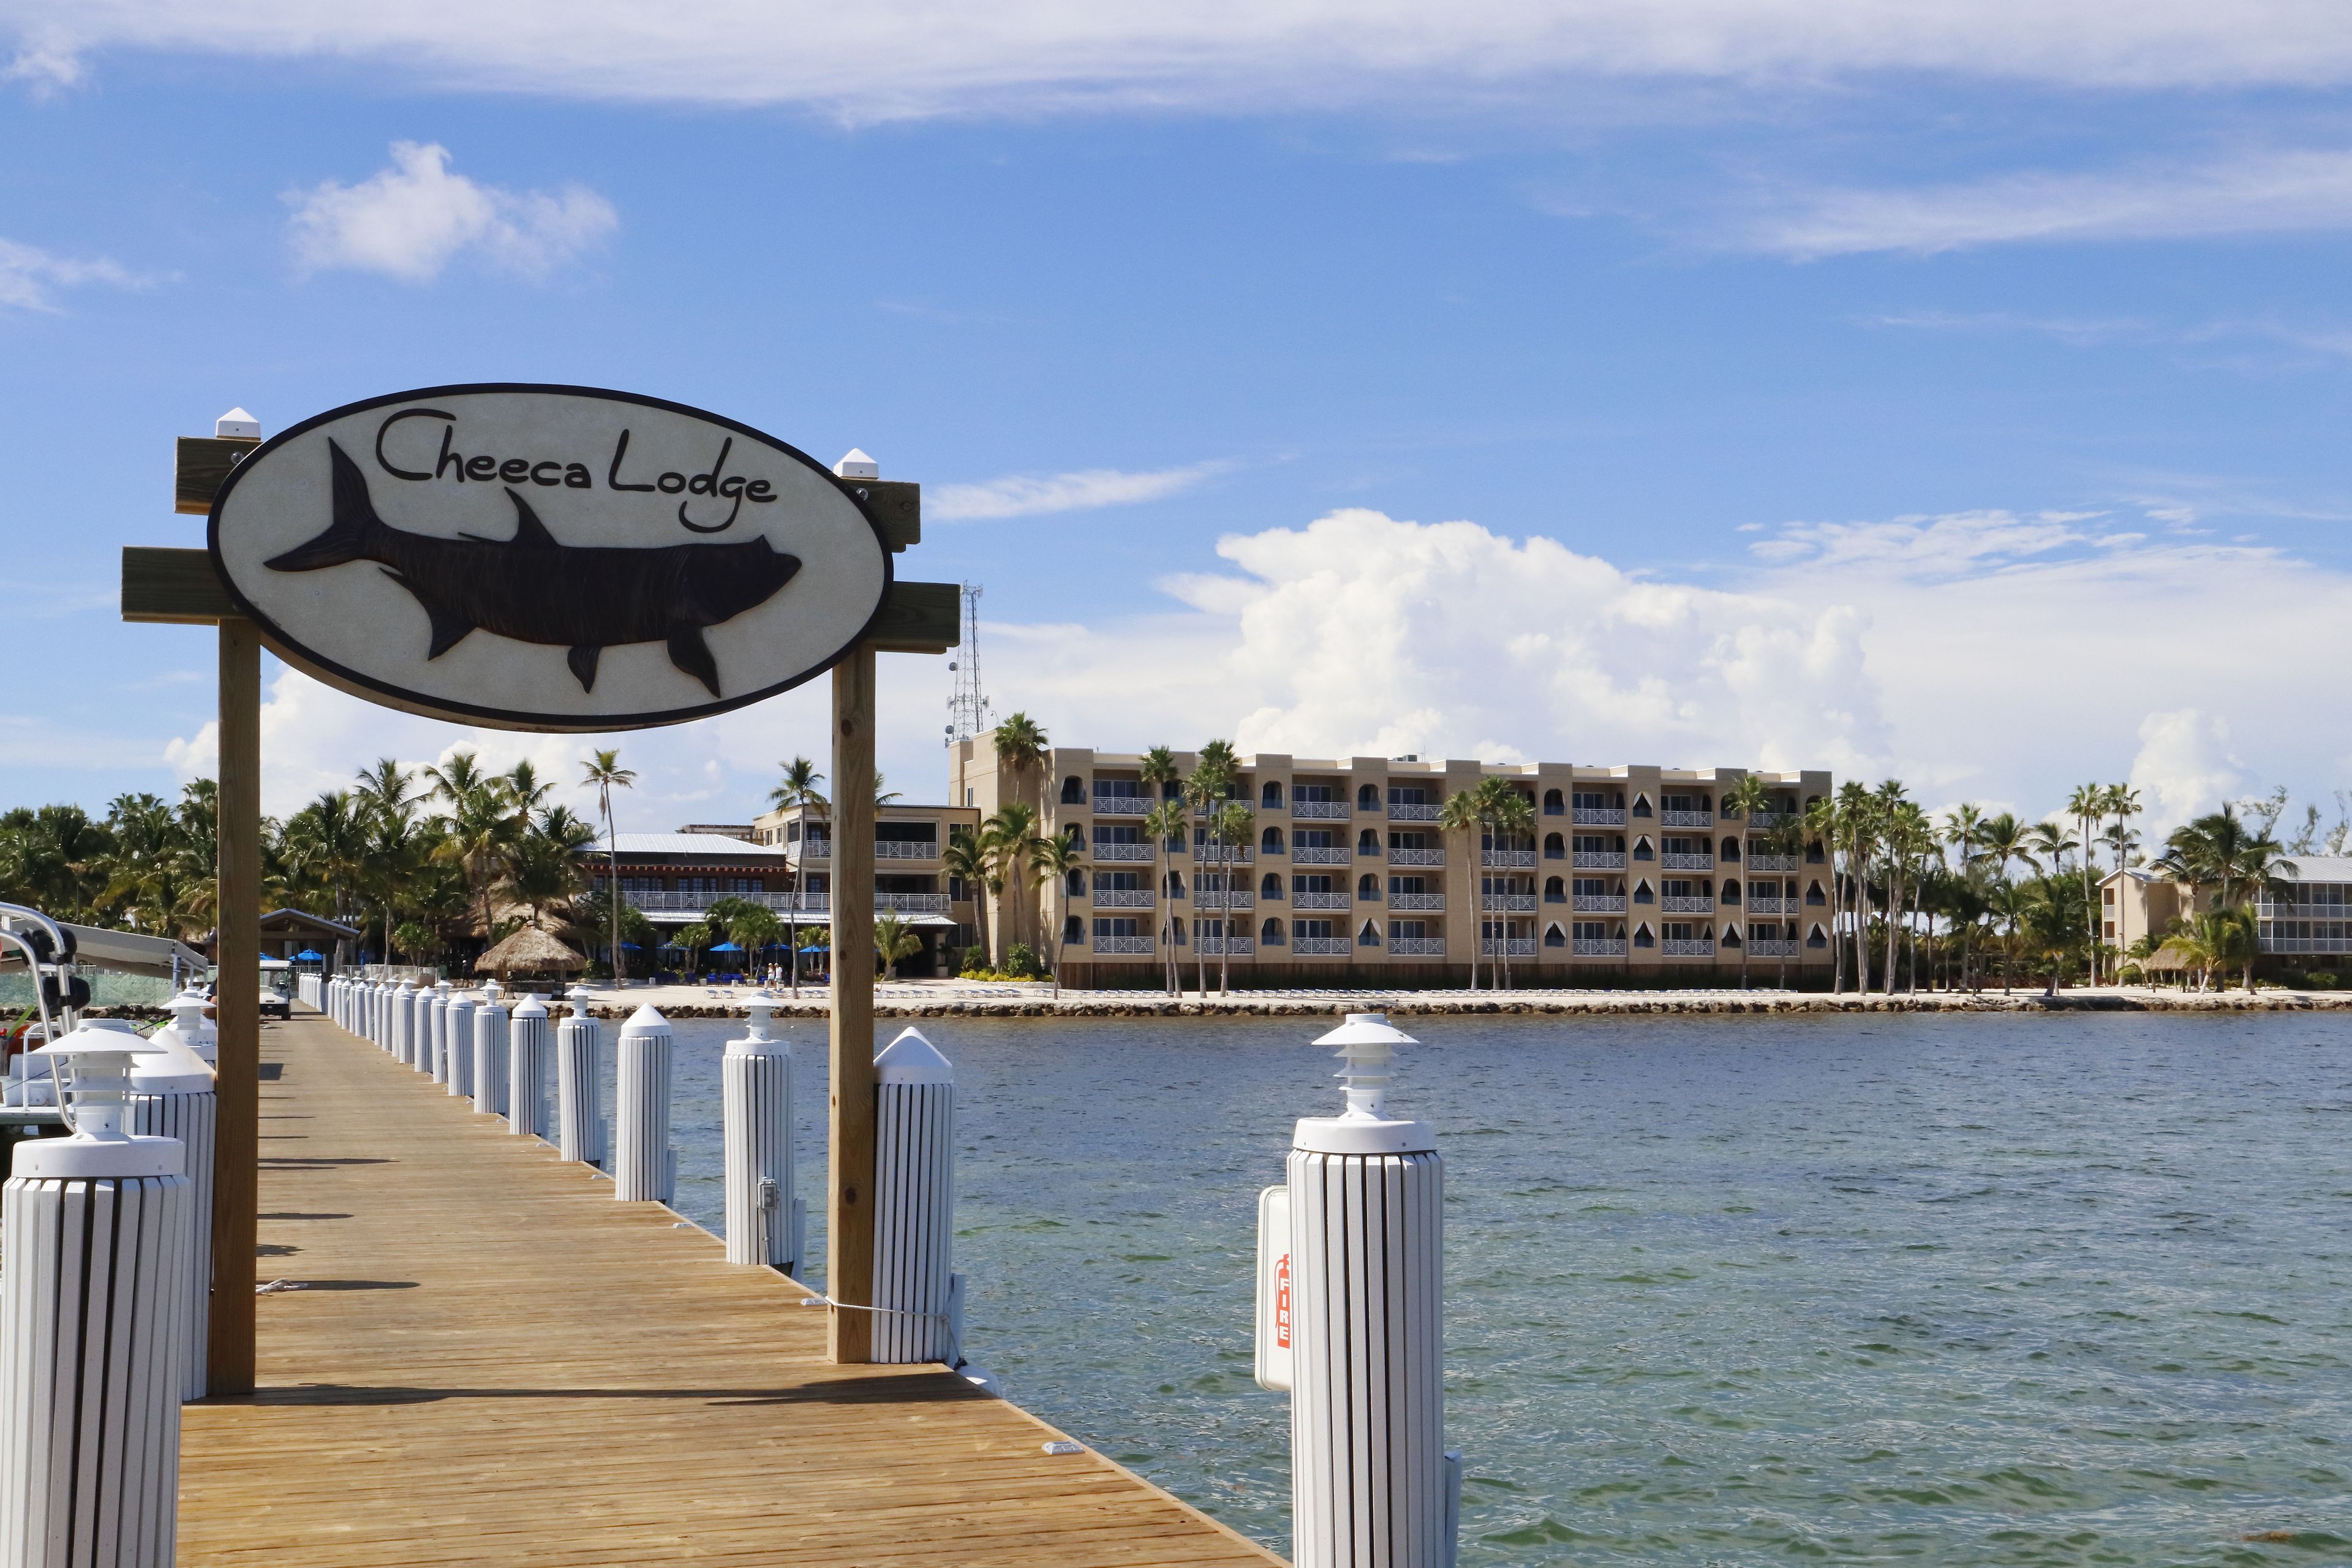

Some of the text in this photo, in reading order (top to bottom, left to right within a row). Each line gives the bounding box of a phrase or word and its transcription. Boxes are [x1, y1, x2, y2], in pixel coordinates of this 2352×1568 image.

[375, 408, 777, 533] Cheeca Lodge
[1279, 1277, 1289, 1341] FIRE
